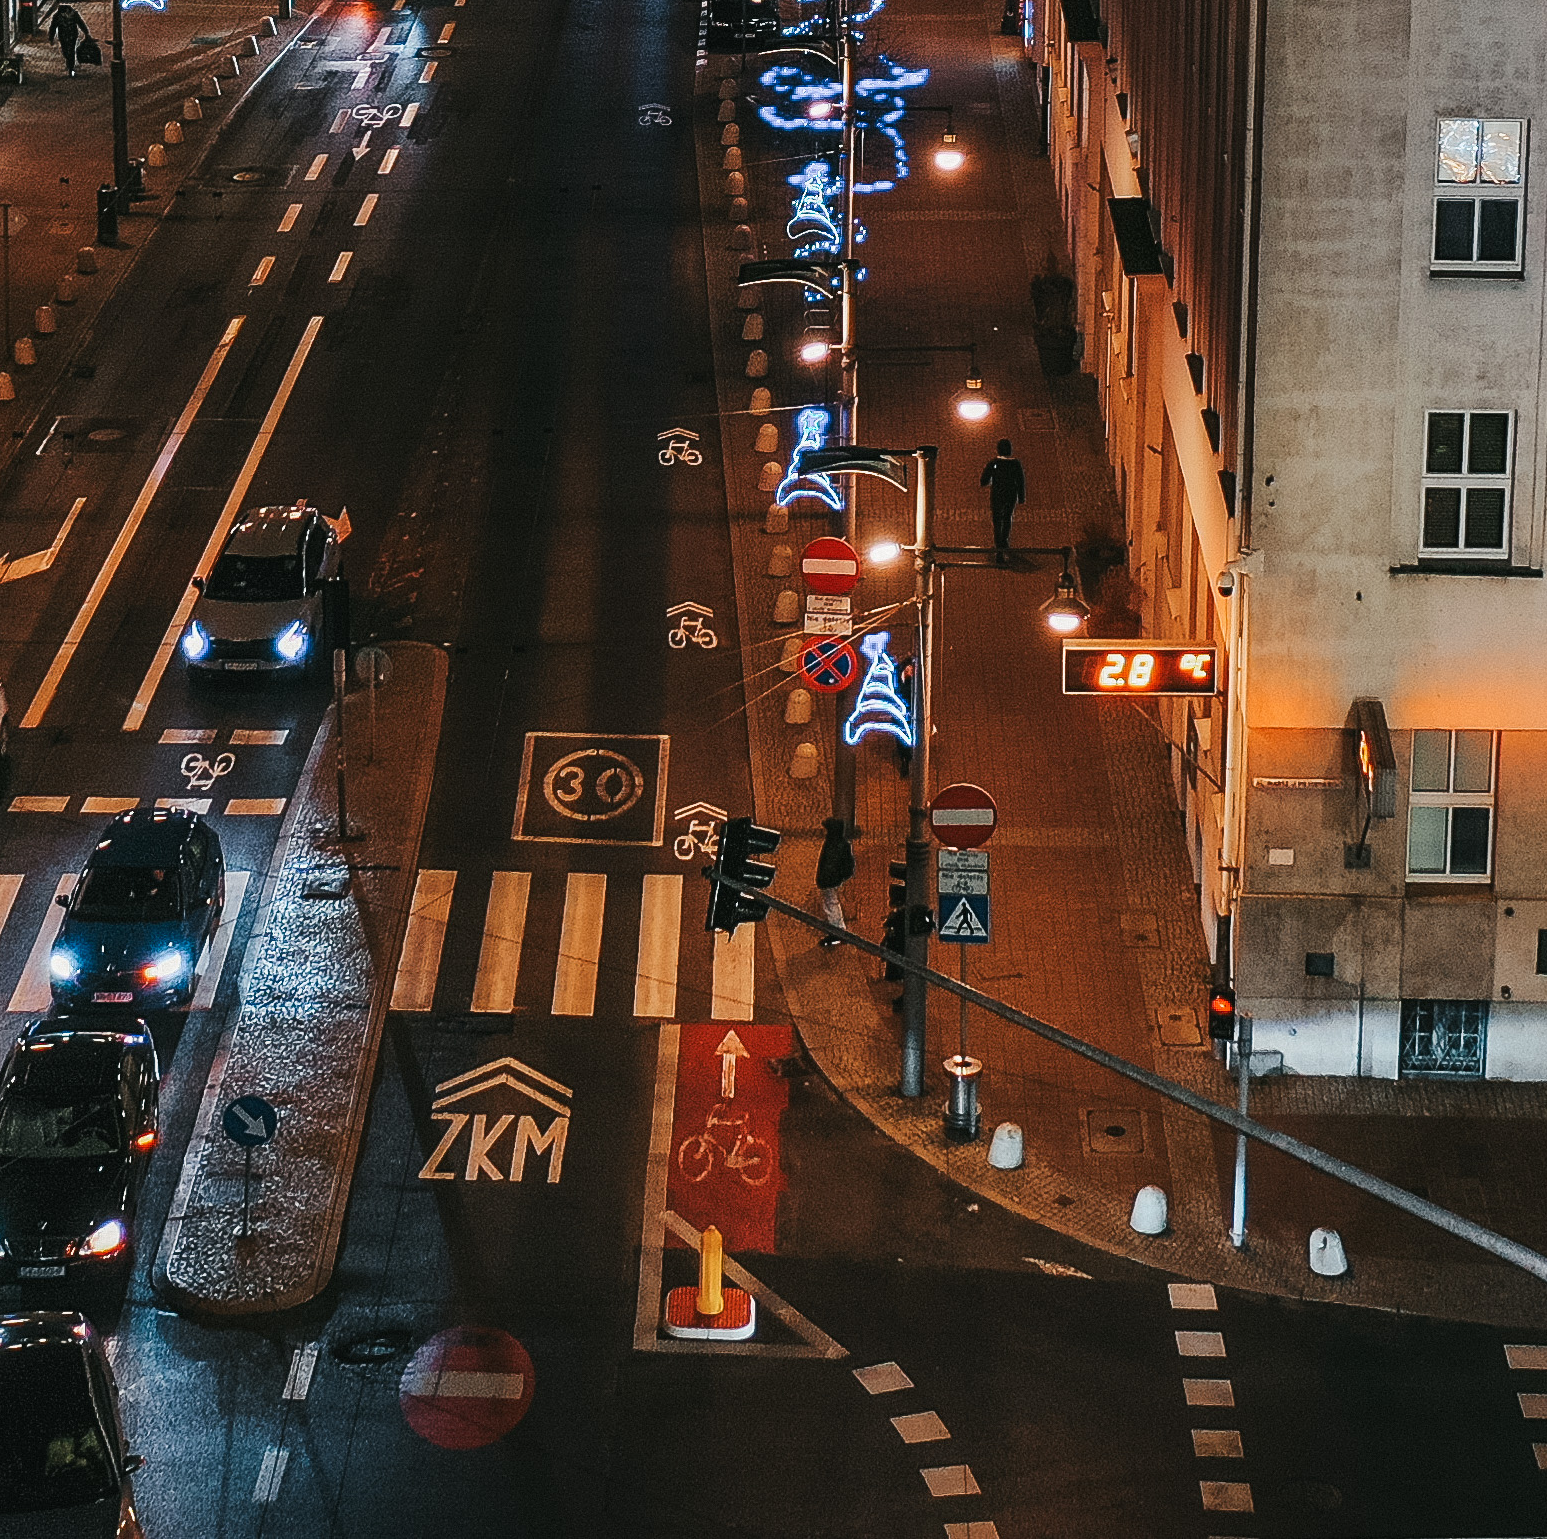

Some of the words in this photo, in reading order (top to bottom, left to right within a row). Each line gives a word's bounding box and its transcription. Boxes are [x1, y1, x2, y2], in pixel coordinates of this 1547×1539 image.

[1099, 653, 1155, 686] 2.8
[557, 766, 632, 803] 30
[418, 1112, 569, 1183] ZKM
